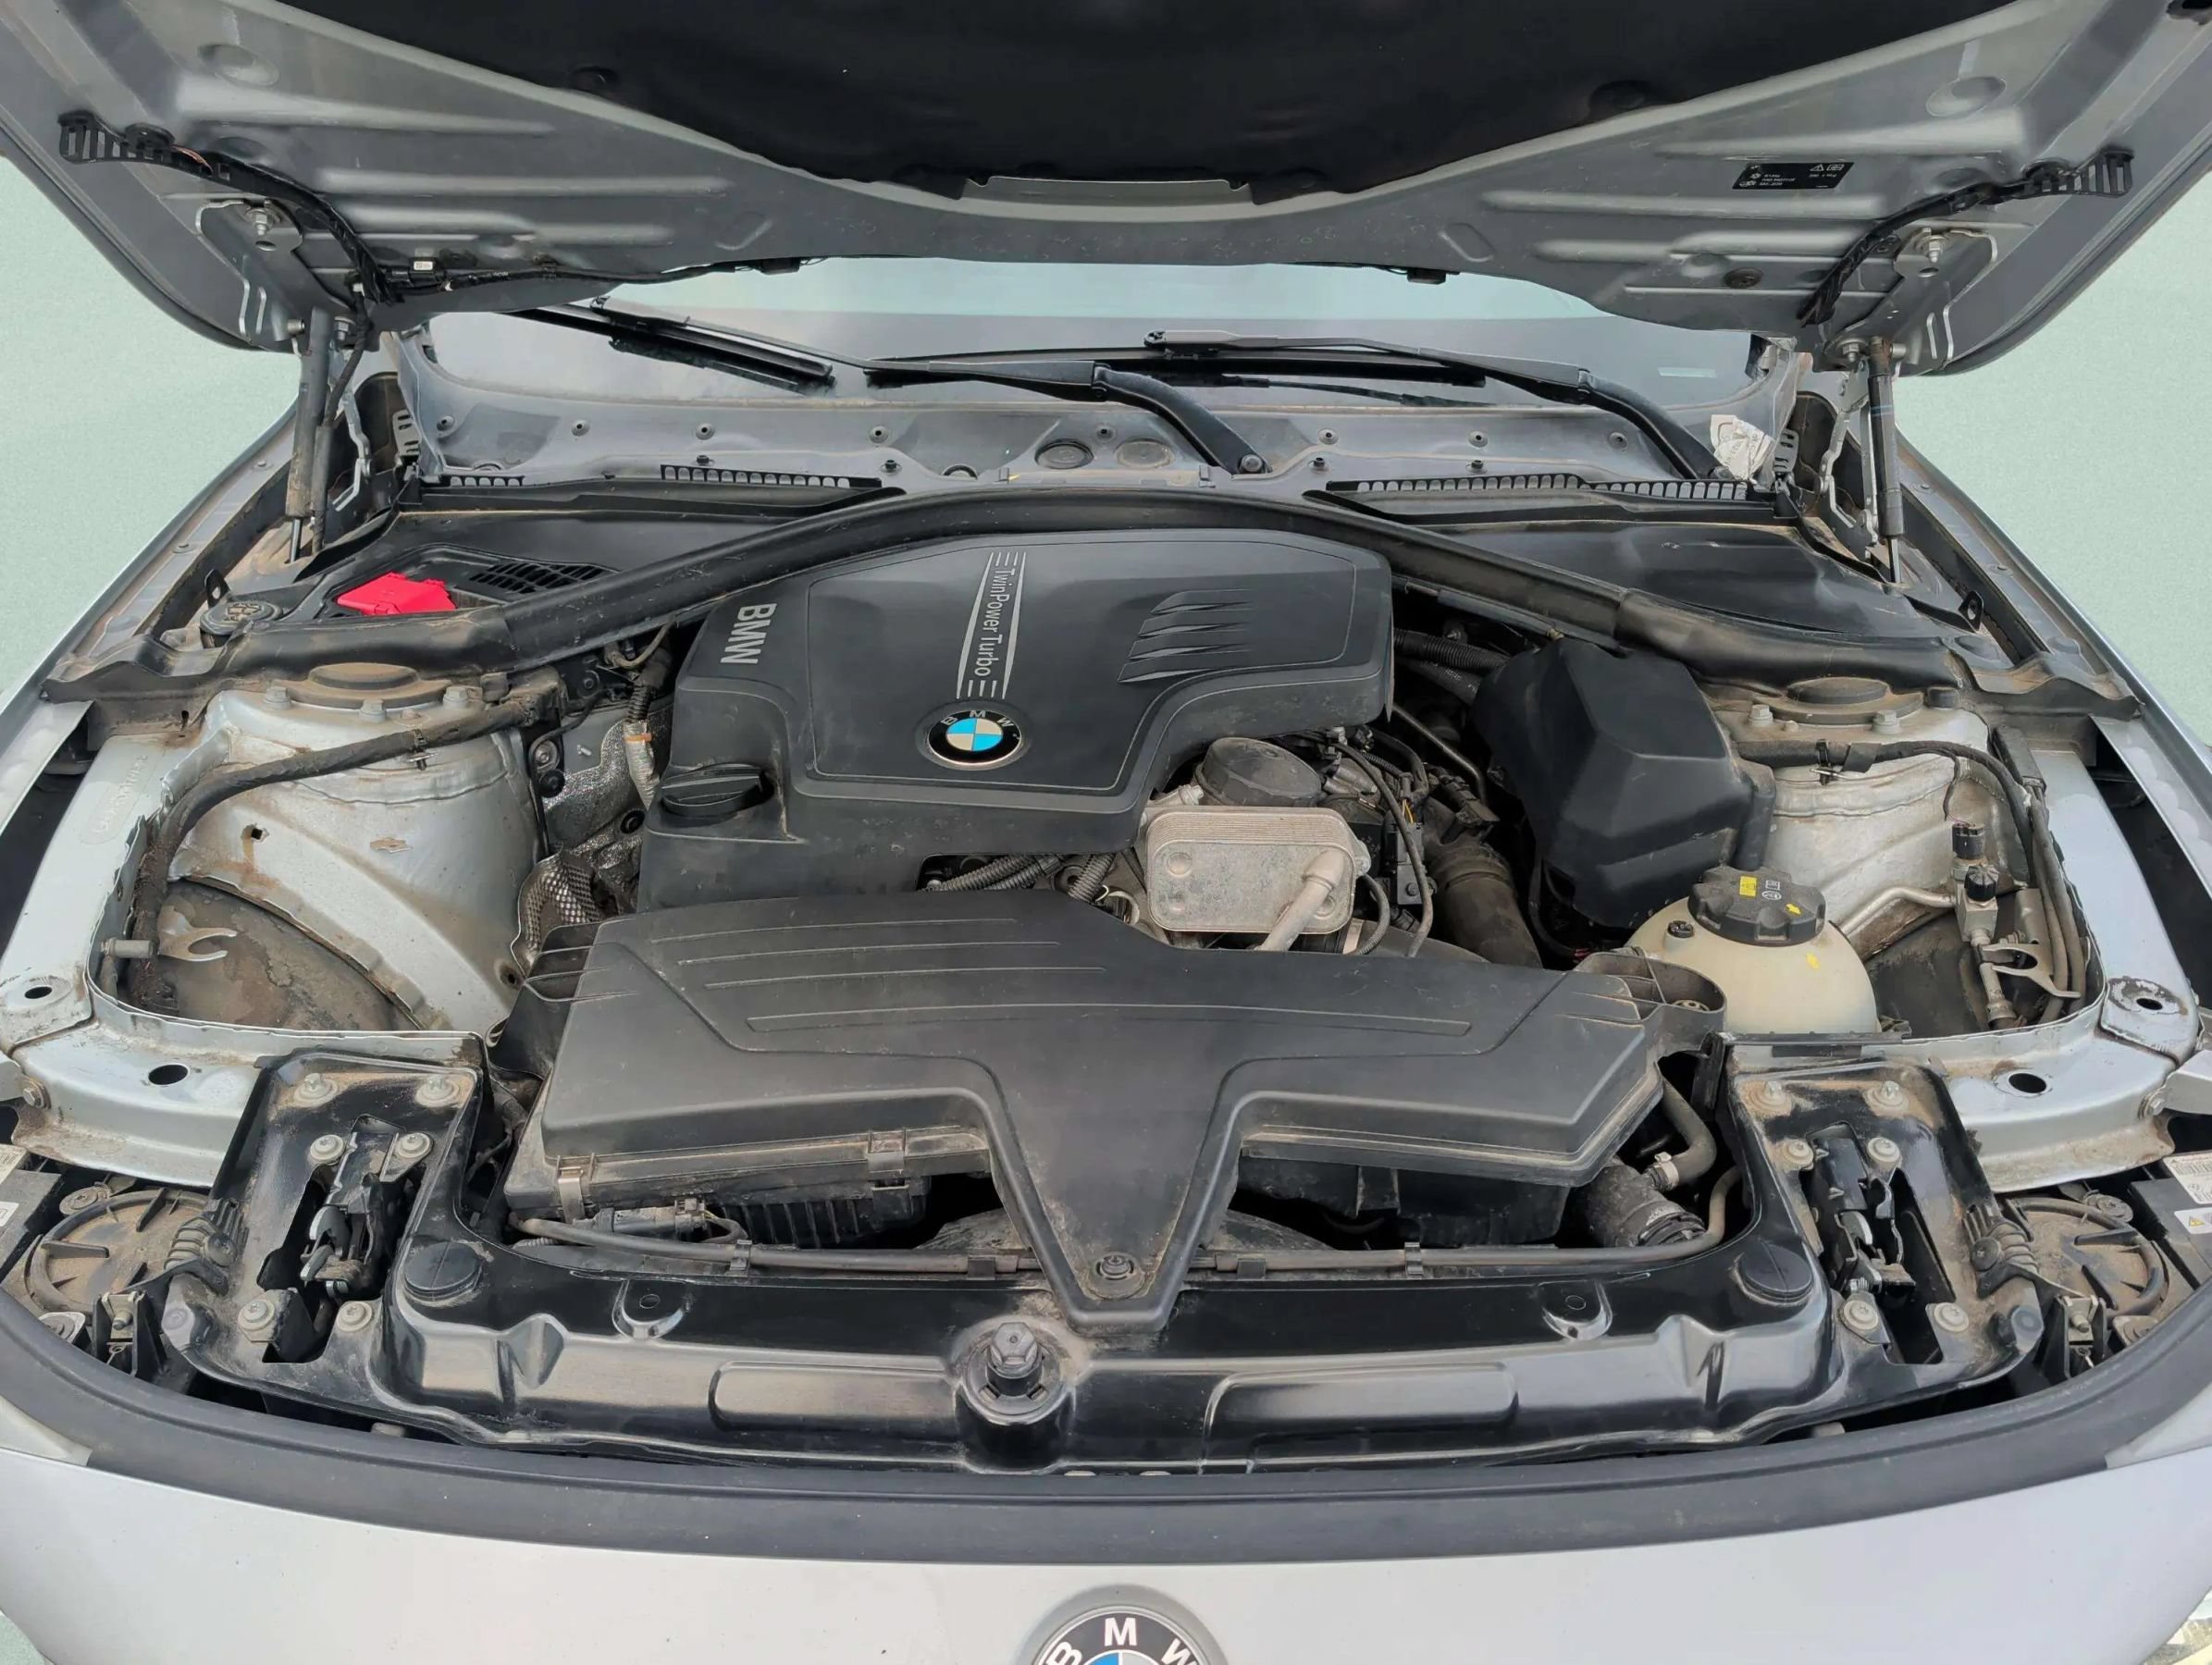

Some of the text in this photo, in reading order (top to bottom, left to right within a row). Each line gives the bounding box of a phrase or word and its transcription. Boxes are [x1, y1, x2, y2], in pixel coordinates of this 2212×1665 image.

[720, 603, 777, 664] BMW
[974, 568, 1015, 677] TwinPower Turbo
[941, 709, 1014, 727] BMW
